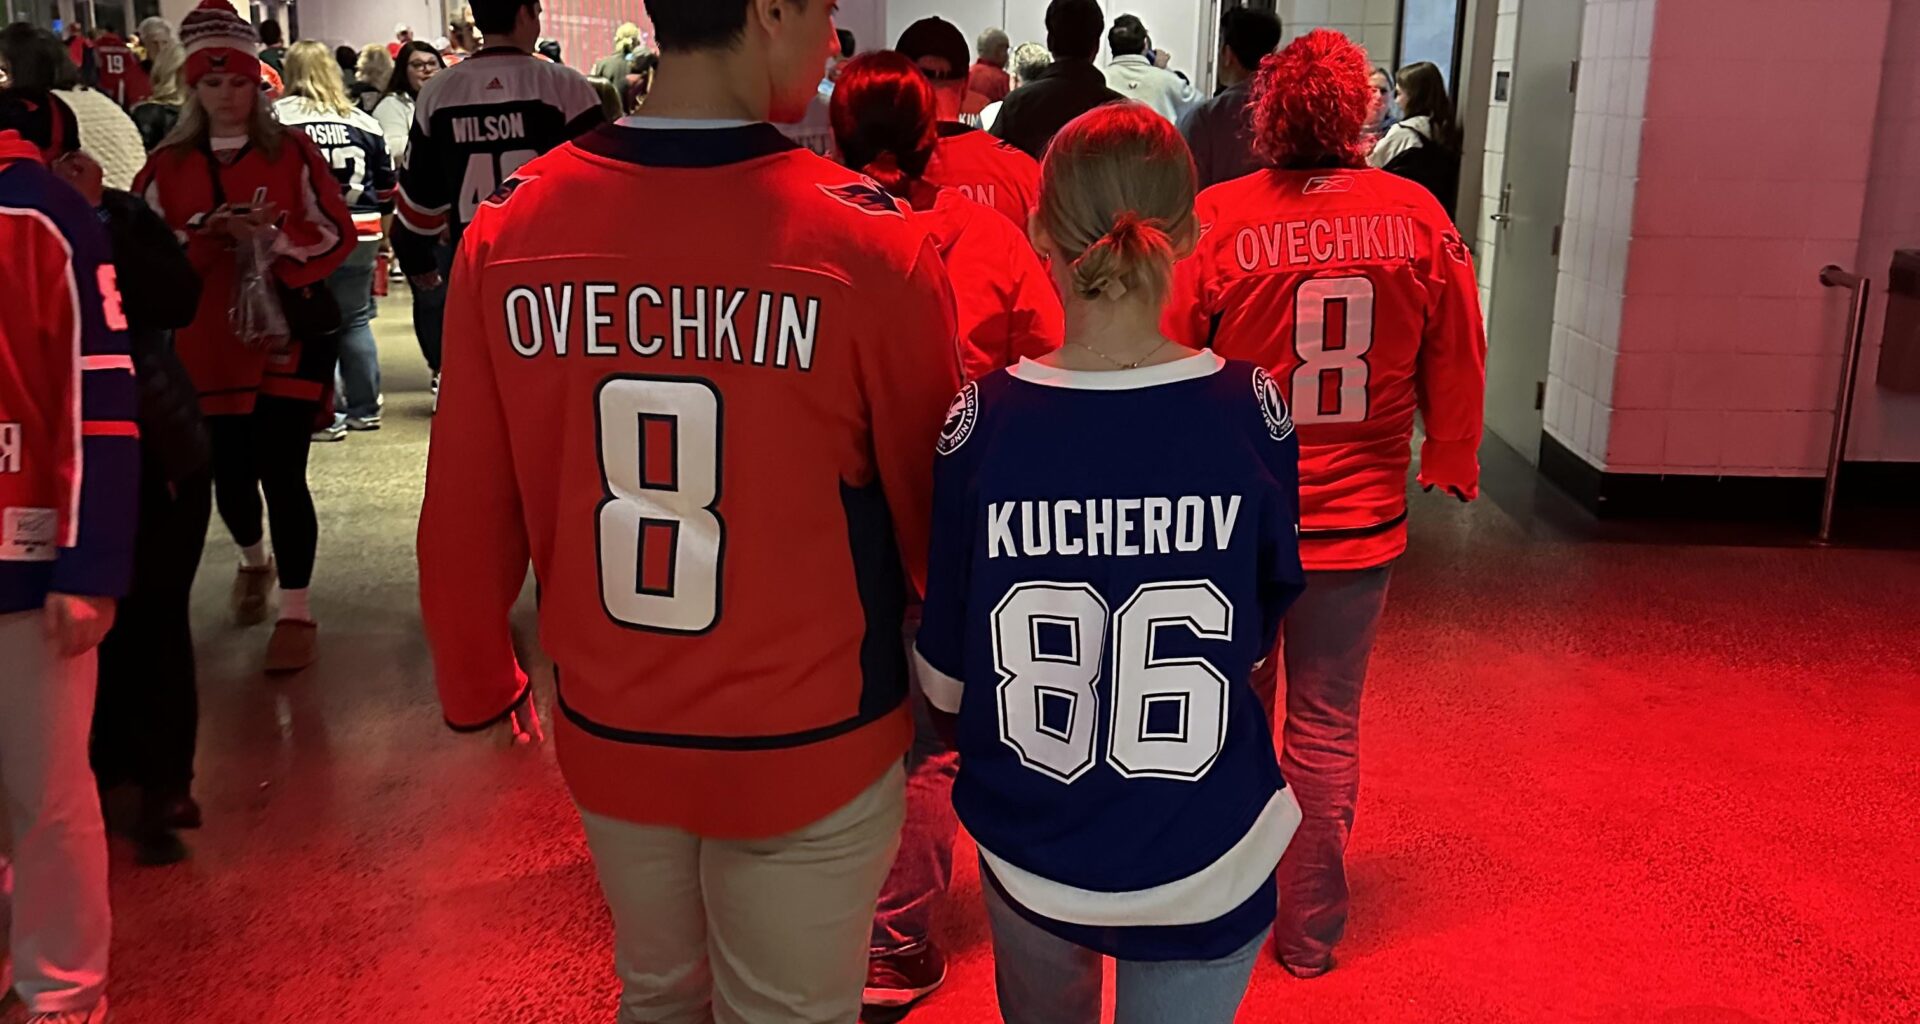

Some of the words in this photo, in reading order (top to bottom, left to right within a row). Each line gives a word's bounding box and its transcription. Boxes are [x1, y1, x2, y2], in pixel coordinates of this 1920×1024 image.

[106, 54, 124, 74] 19
[305, 123, 351, 145] OSHIE
[451, 112, 525, 143] WILSON
[320, 146, 366, 207] 7
[1234, 214, 1416, 272] OVECHKIN
[503, 282, 822, 371] OVECHKIN
[1291, 274, 1376, 425] 8
[593, 372, 727, 637] 8
[987, 494, 1242, 559] KUCHEROV
[990, 578, 1234, 785] 86
